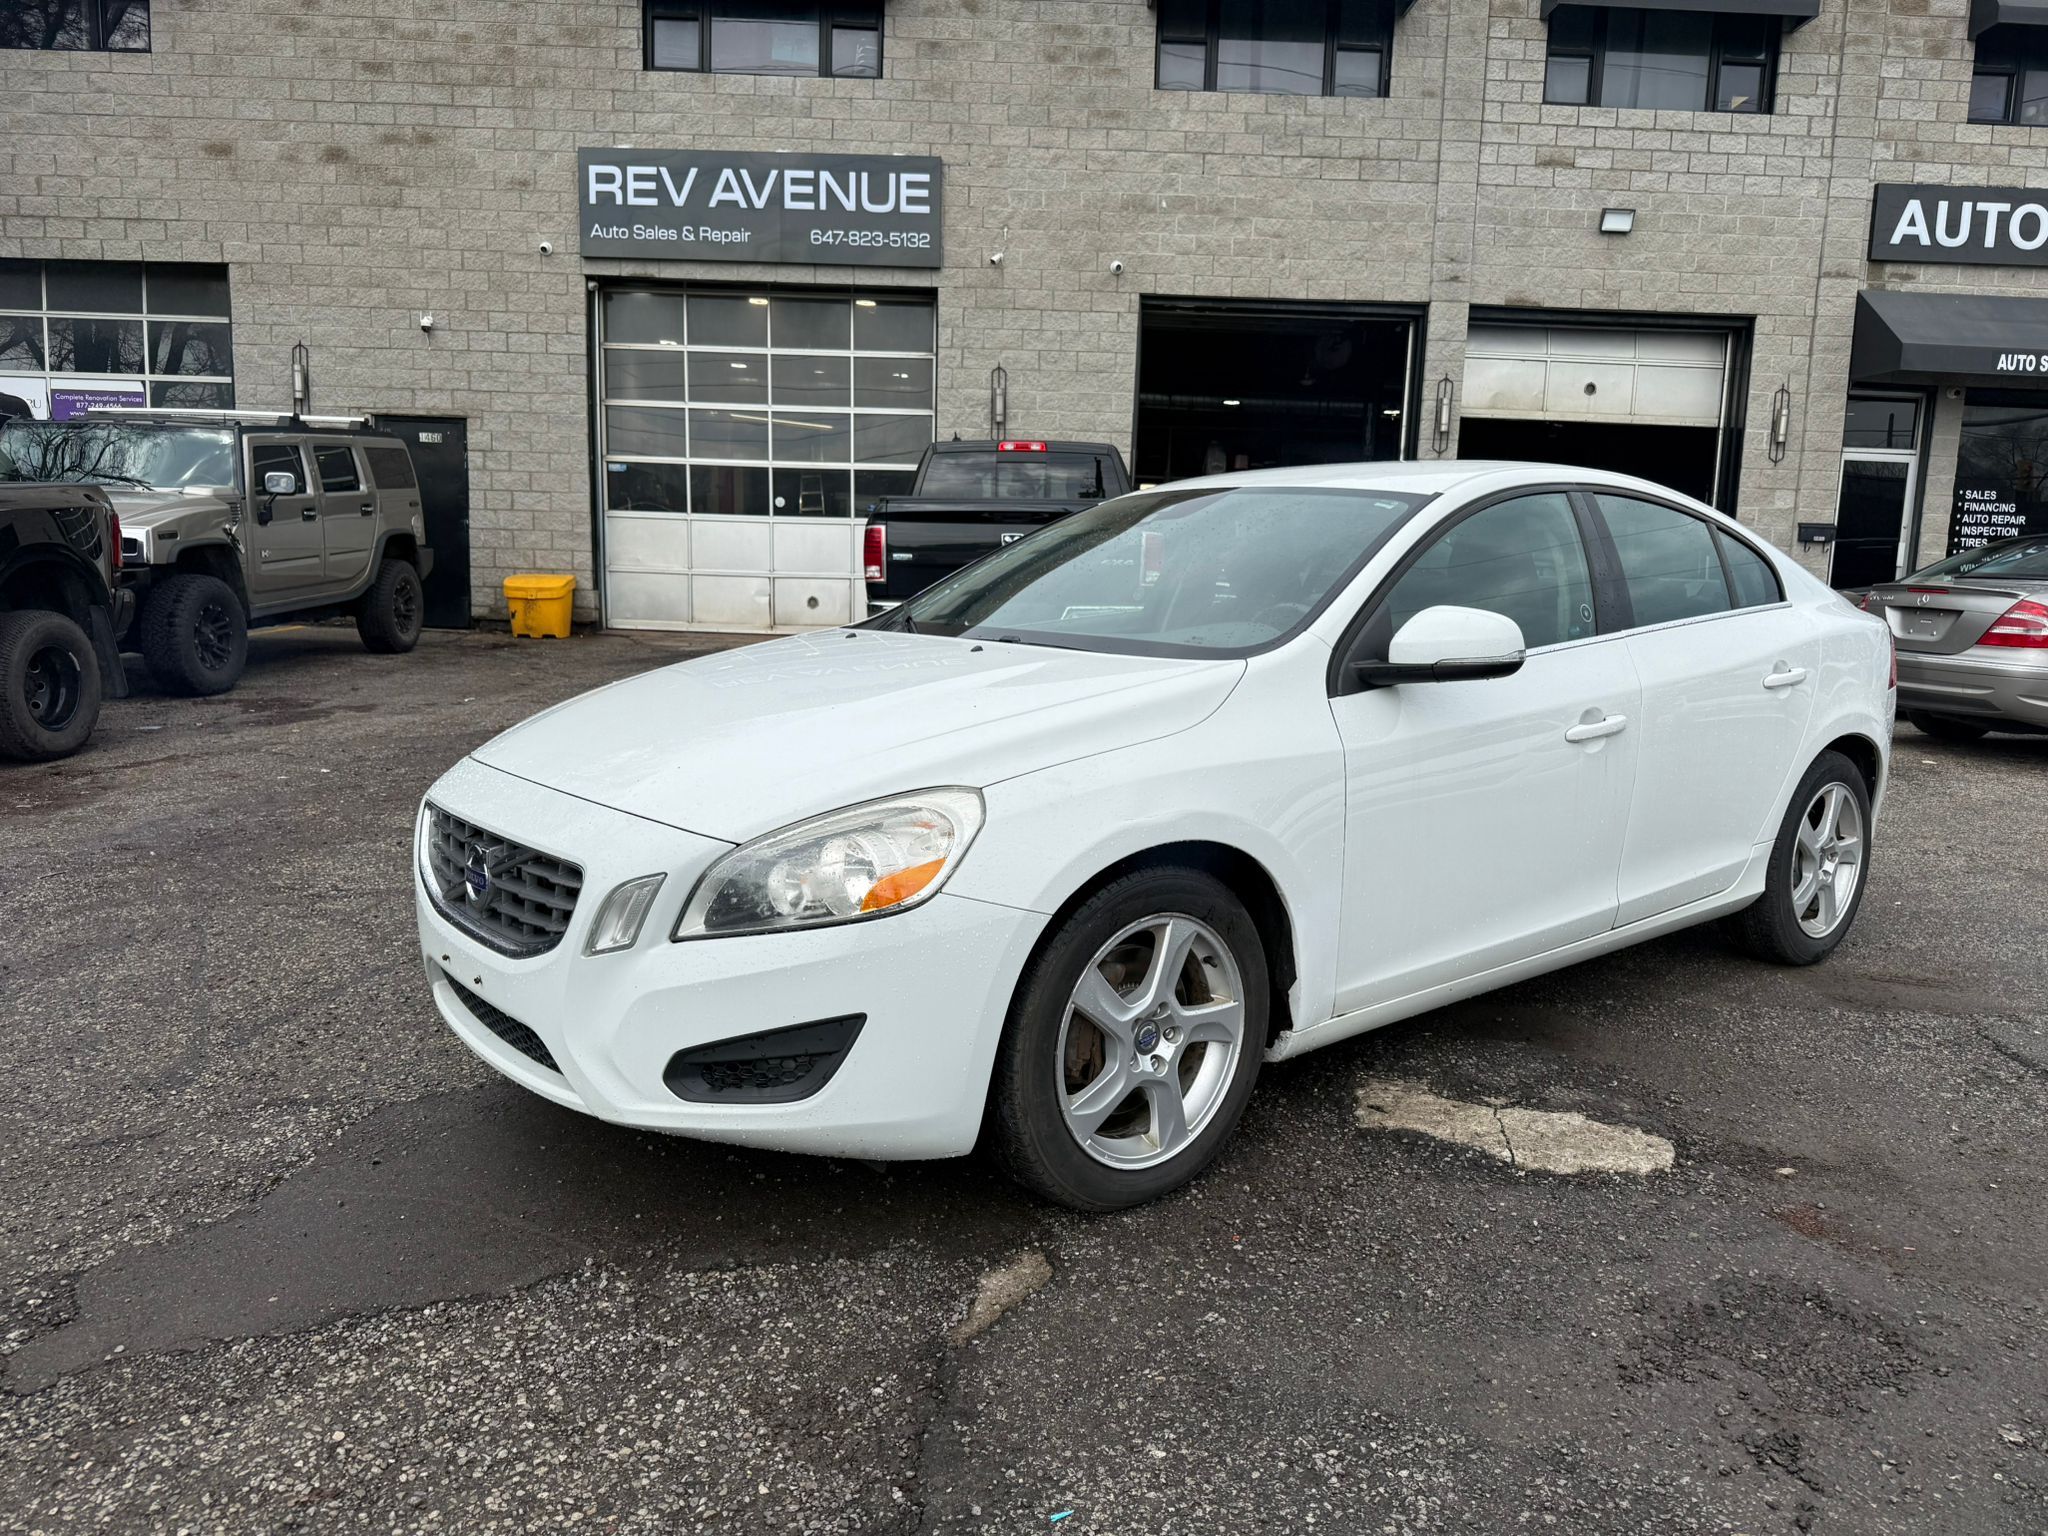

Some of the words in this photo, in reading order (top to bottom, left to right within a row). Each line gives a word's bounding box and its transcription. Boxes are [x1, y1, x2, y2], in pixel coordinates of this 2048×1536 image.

[588, 164, 699, 207] REV
[708, 168, 931, 214] AVENUE
[1889, 199, 2048, 250] AUTO
[590, 223, 629, 240] Auto
[633, 224, 678, 241] Sales
[682, 225, 695, 241] &
[700, 226, 751, 245] Repair
[810, 229, 931, 248] 647-823-5132
[1996, 353, 2037, 371] AUTO
[55, 393, 84, 401] Complete
[85, 393, 118, 402] Renovation
[119, 395, 142, 403] Services
[1965, 490, 1997, 500] SALES
[1964, 502, 2016, 513] FINANCING
[1962, 514, 1989, 524] AUTO
[1991, 515, 2026, 525] REPAIR
[1961, 526, 2019, 537] INSPECTION
[1960, 538, 1988, 548] TIRES
